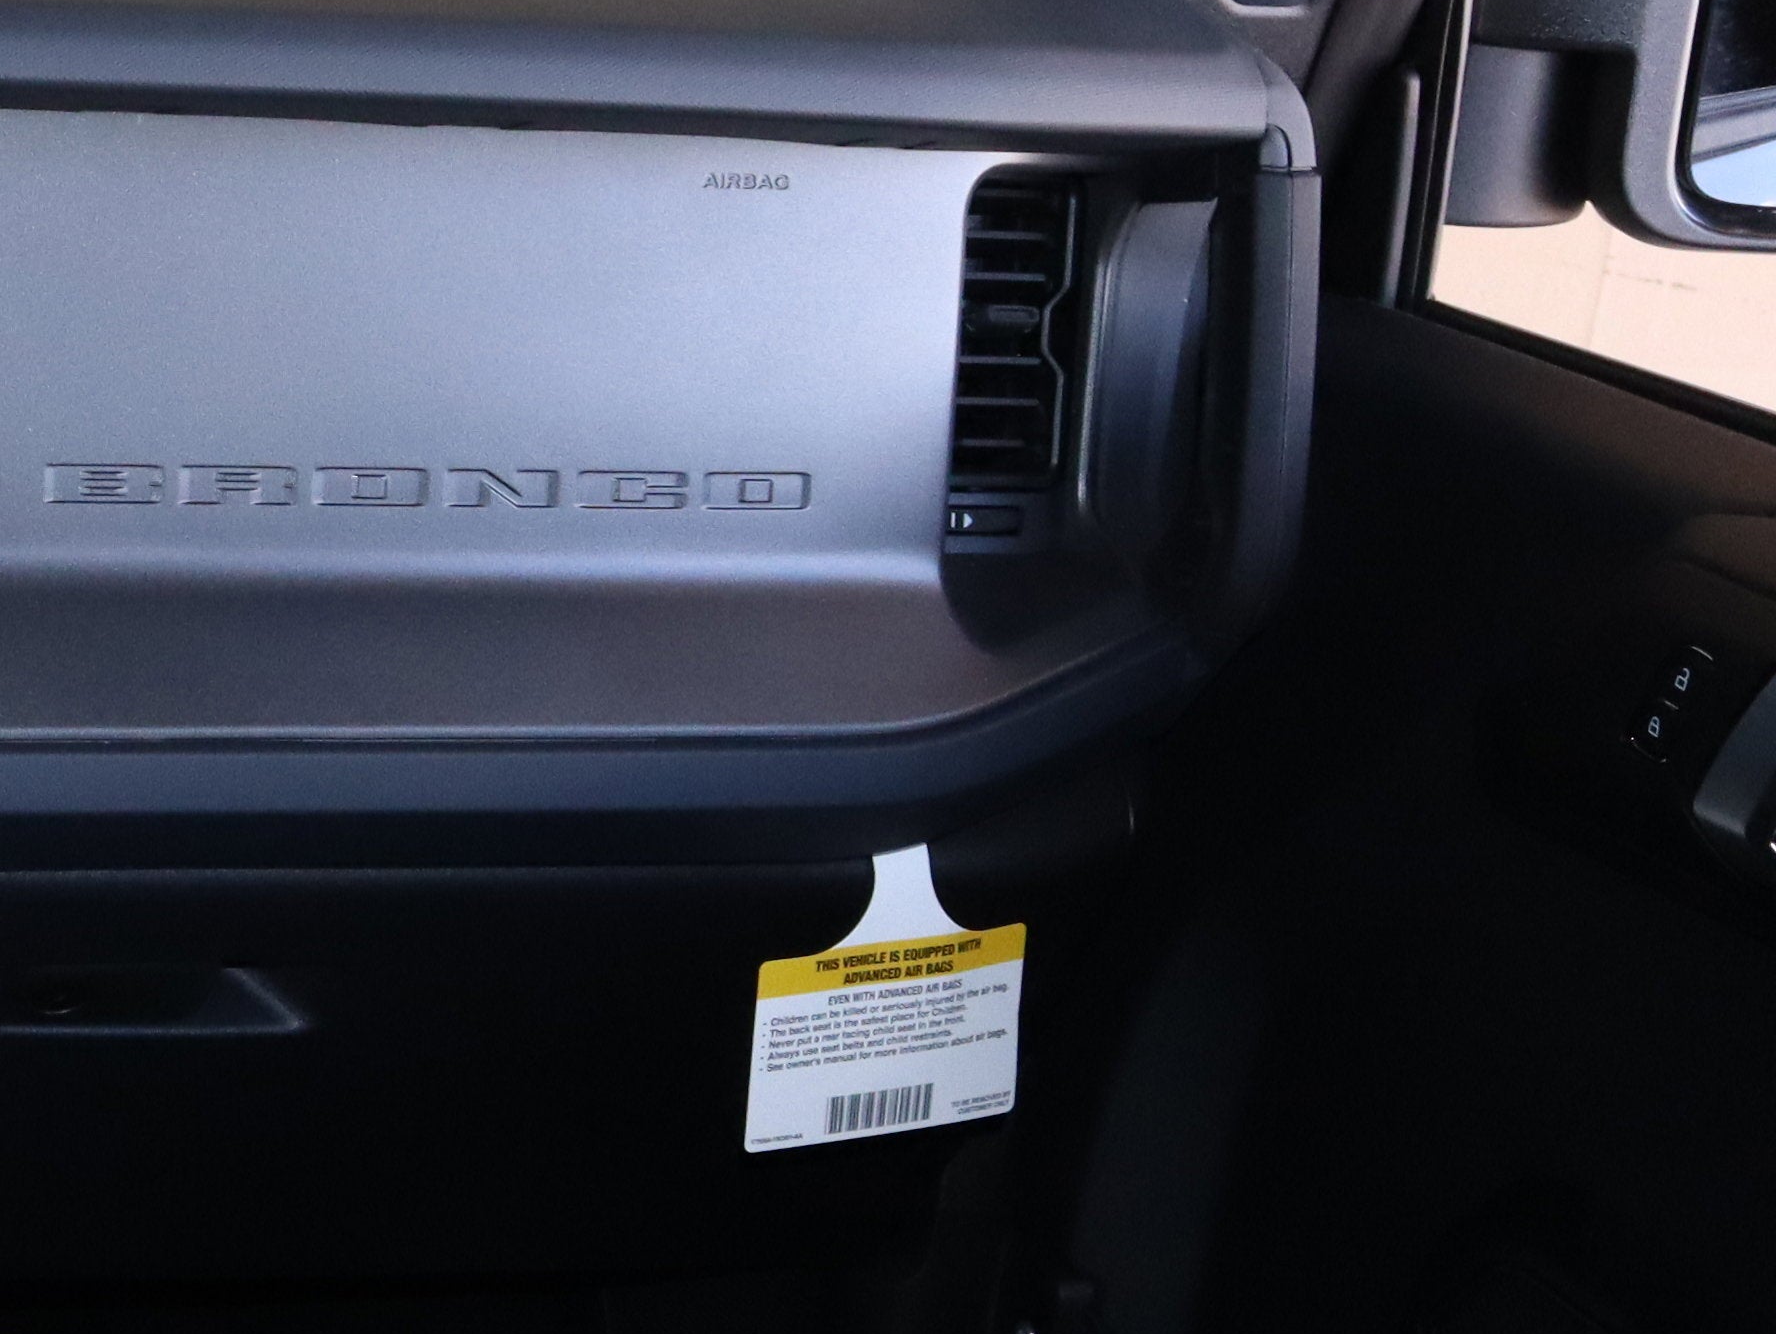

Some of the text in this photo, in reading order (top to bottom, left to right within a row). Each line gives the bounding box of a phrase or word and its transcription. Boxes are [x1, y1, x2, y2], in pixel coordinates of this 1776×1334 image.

[702, 172, 790, 191] AIRBAG
[43, 463, 812, 511] BRONCO
[816, 938, 981, 972] THIS VEHICLE IS EQUIPPED WITH
[843, 960, 954, 984] ADVANCED AIR BAGS
[828, 979, 963, 1006] EVEN WITH ADVANCED AIR BAGS
